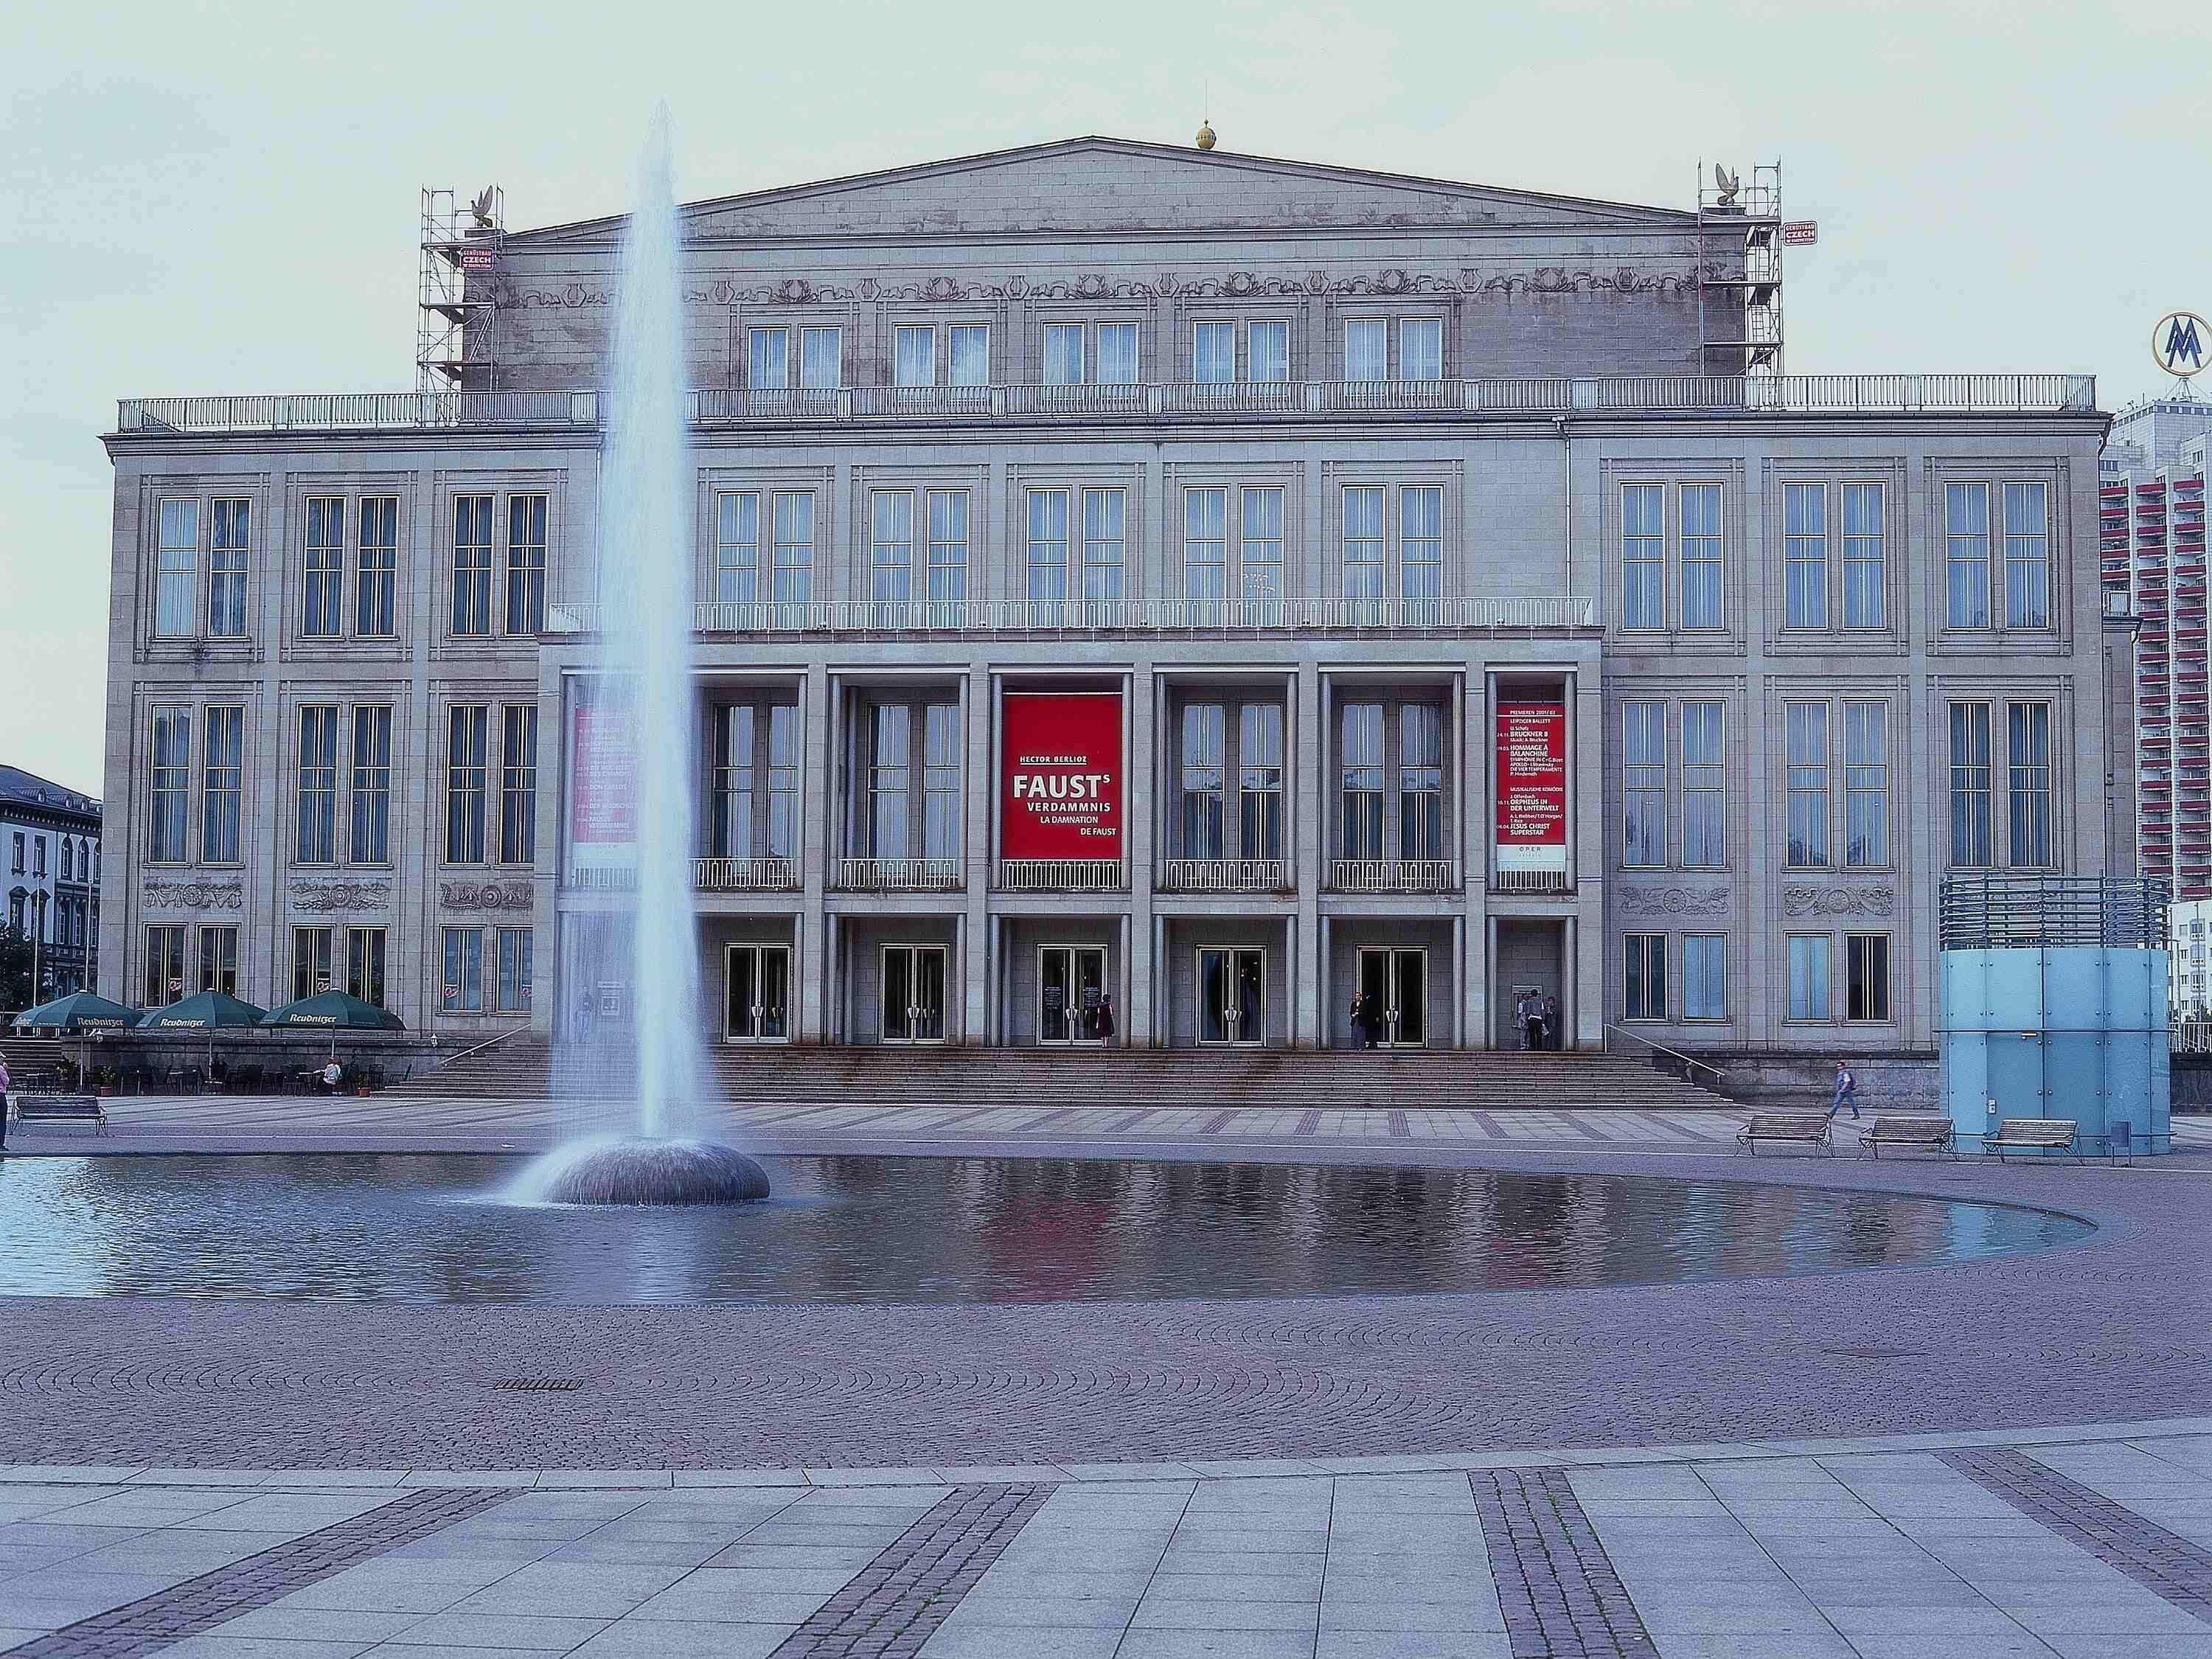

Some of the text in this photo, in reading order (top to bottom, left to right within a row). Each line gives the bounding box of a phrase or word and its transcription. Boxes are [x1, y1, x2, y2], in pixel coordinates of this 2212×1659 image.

[1786, 230, 1815, 238] CZECH
[1026, 802, 1110, 812] VERDAMMNIS
[1080, 827, 1116, 835] DE FAUST
[77, 1017, 124, 1026] Reudnitzer
[160, 1018, 206, 1028] Reudnitzer
[290, 1014, 336, 1024] Reudnitzer
